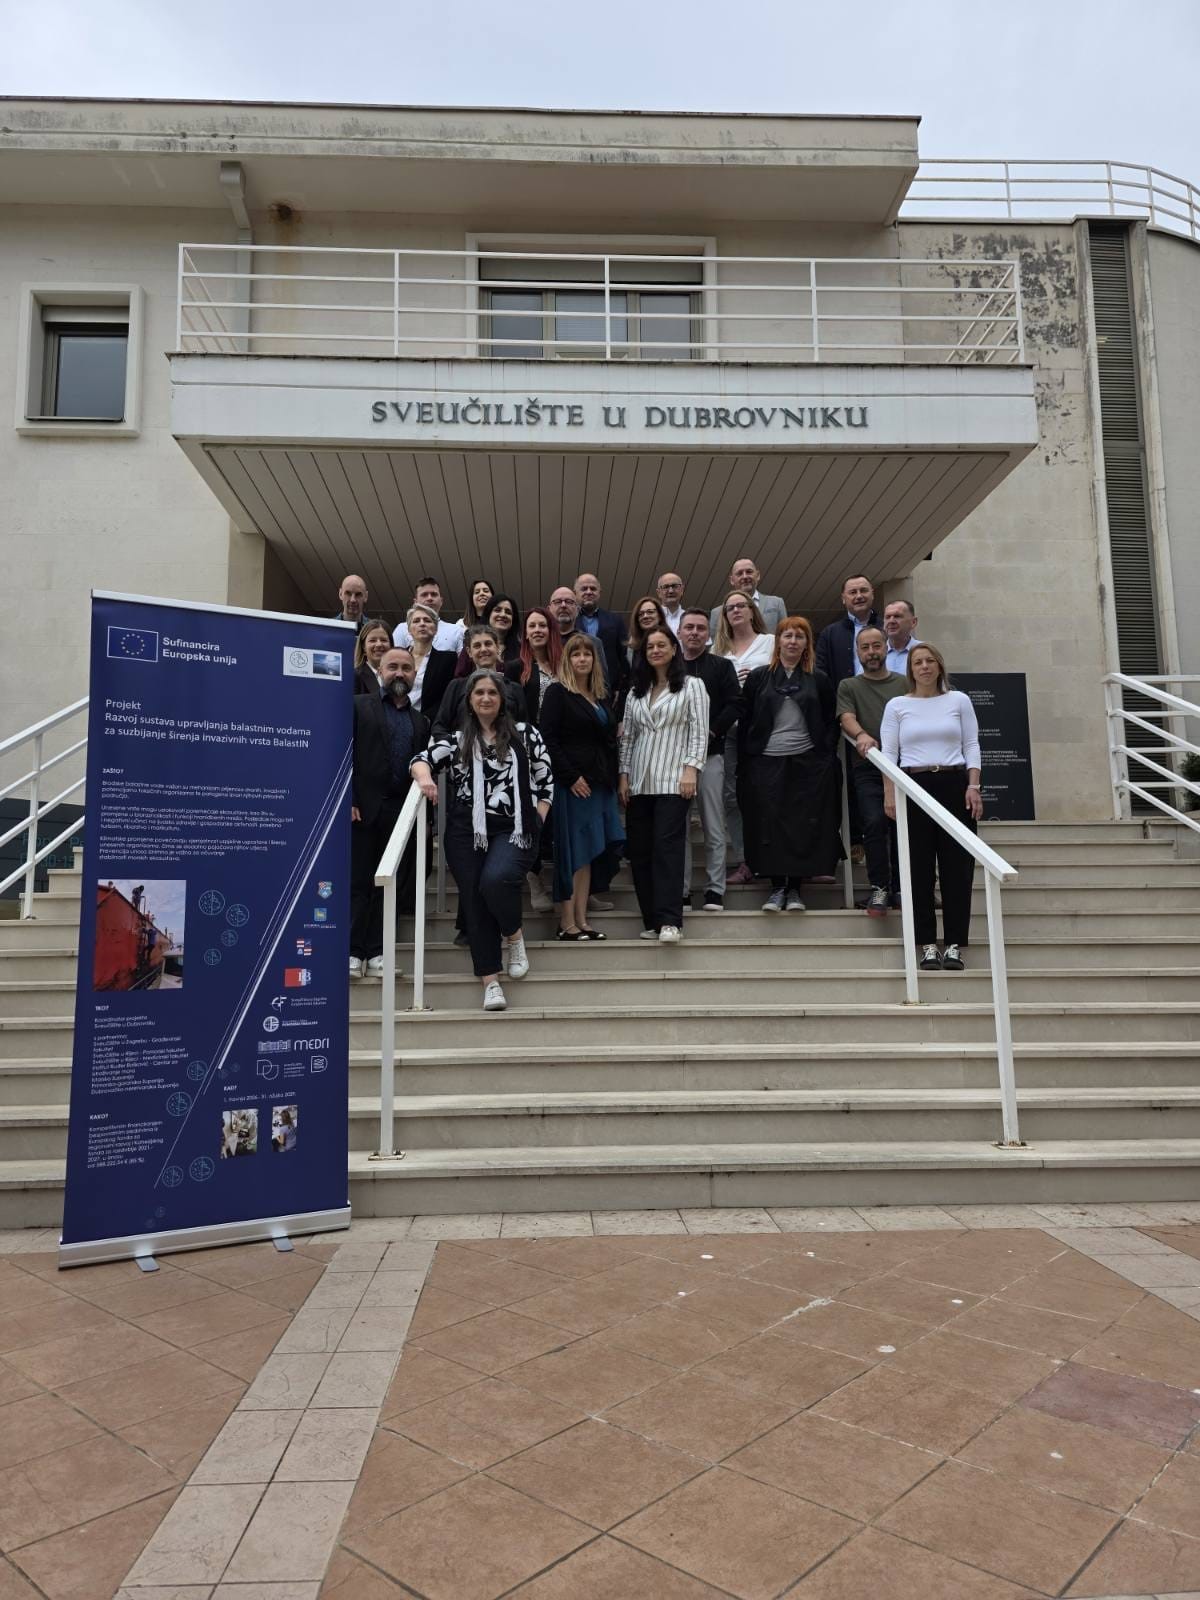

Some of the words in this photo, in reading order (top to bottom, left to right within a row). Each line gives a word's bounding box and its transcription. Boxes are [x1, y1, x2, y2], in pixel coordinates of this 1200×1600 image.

[371, 396, 585, 427] SVEUČILIŠTE
[602, 406, 627, 429] U
[644, 406, 870, 429] DUBROVNIKU
[162, 636, 220, 651] Sufinancira
[162, 648, 211, 662] Europska
[212, 655, 238, 666] unija
[105, 698, 142, 711] Projekt
[104, 712, 138, 725] Razvoj
[140, 716, 175, 726] sustava
[177, 720, 229, 732] upravljanja
[230, 722, 274, 734] balastnim
[276, 726, 312, 736] vodama
[104, 727, 116, 736] za
[118, 728, 167, 740] suzbijanje
[168, 730, 200, 742] širenja
[202, 733, 248, 744] invazivnih
[249, 737, 272, 746] vrsta
